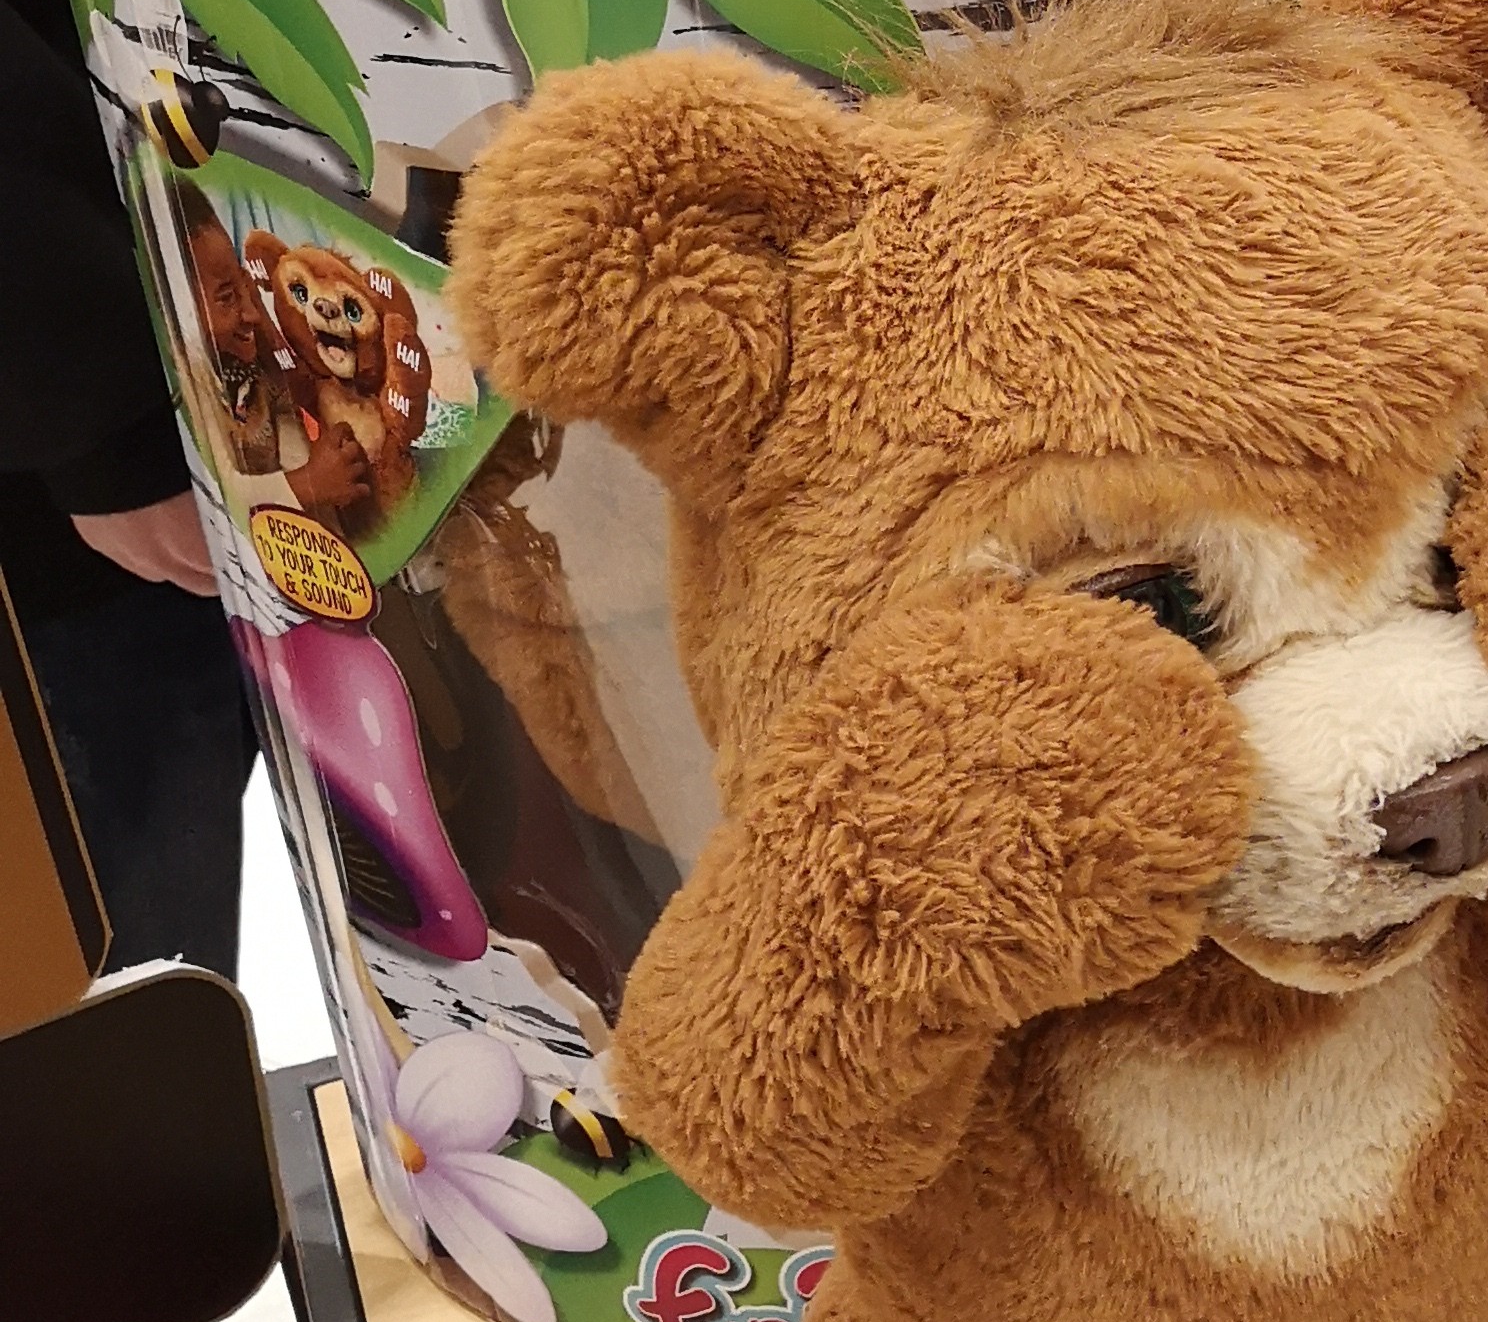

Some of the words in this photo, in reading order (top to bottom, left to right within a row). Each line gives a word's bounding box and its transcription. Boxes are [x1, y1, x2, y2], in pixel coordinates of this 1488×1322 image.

[369, 269, 393, 300] HA!
[396, 341, 421, 372] HA!
[387, 387, 410, 418] HA!
[266, 515, 342, 563] RESPONDS
[275, 543, 318, 579] YOUR
[319, 558, 368, 599] TOUCH
[284, 571, 299, 596] &
[301, 578, 352, 615] SOUND
